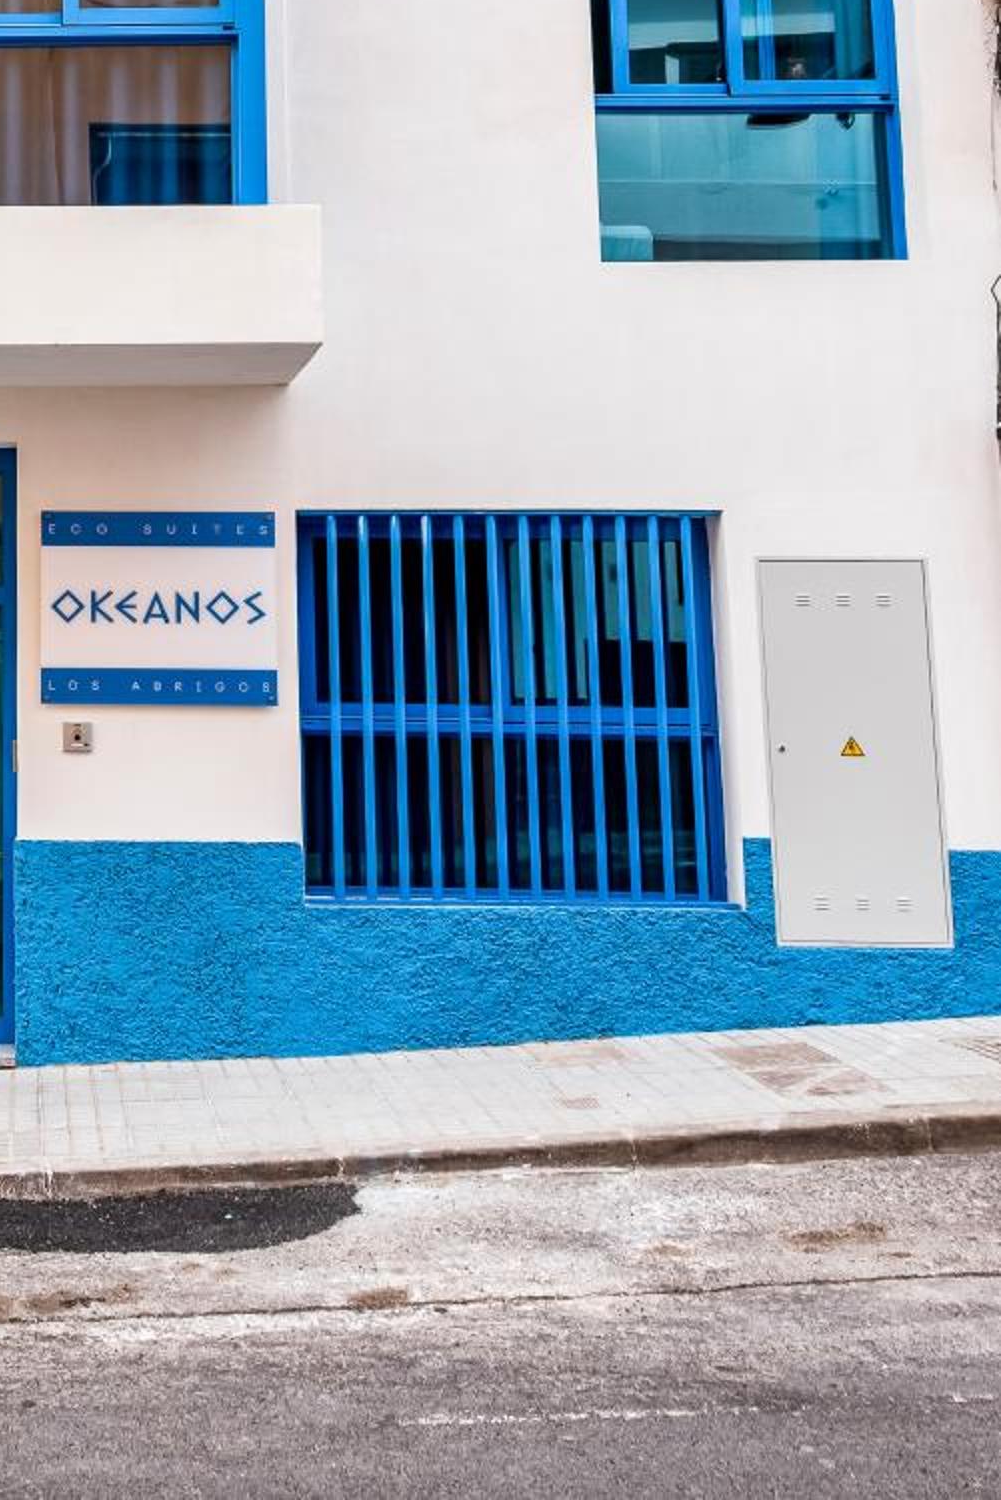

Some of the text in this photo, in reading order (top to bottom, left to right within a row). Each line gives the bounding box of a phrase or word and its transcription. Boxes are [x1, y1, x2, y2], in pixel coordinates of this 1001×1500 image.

[48, 523, 108, 536] ECO
[51, 589, 266, 625] OKEANOS
[48, 679, 271, 693] LOS ABRIGOS
